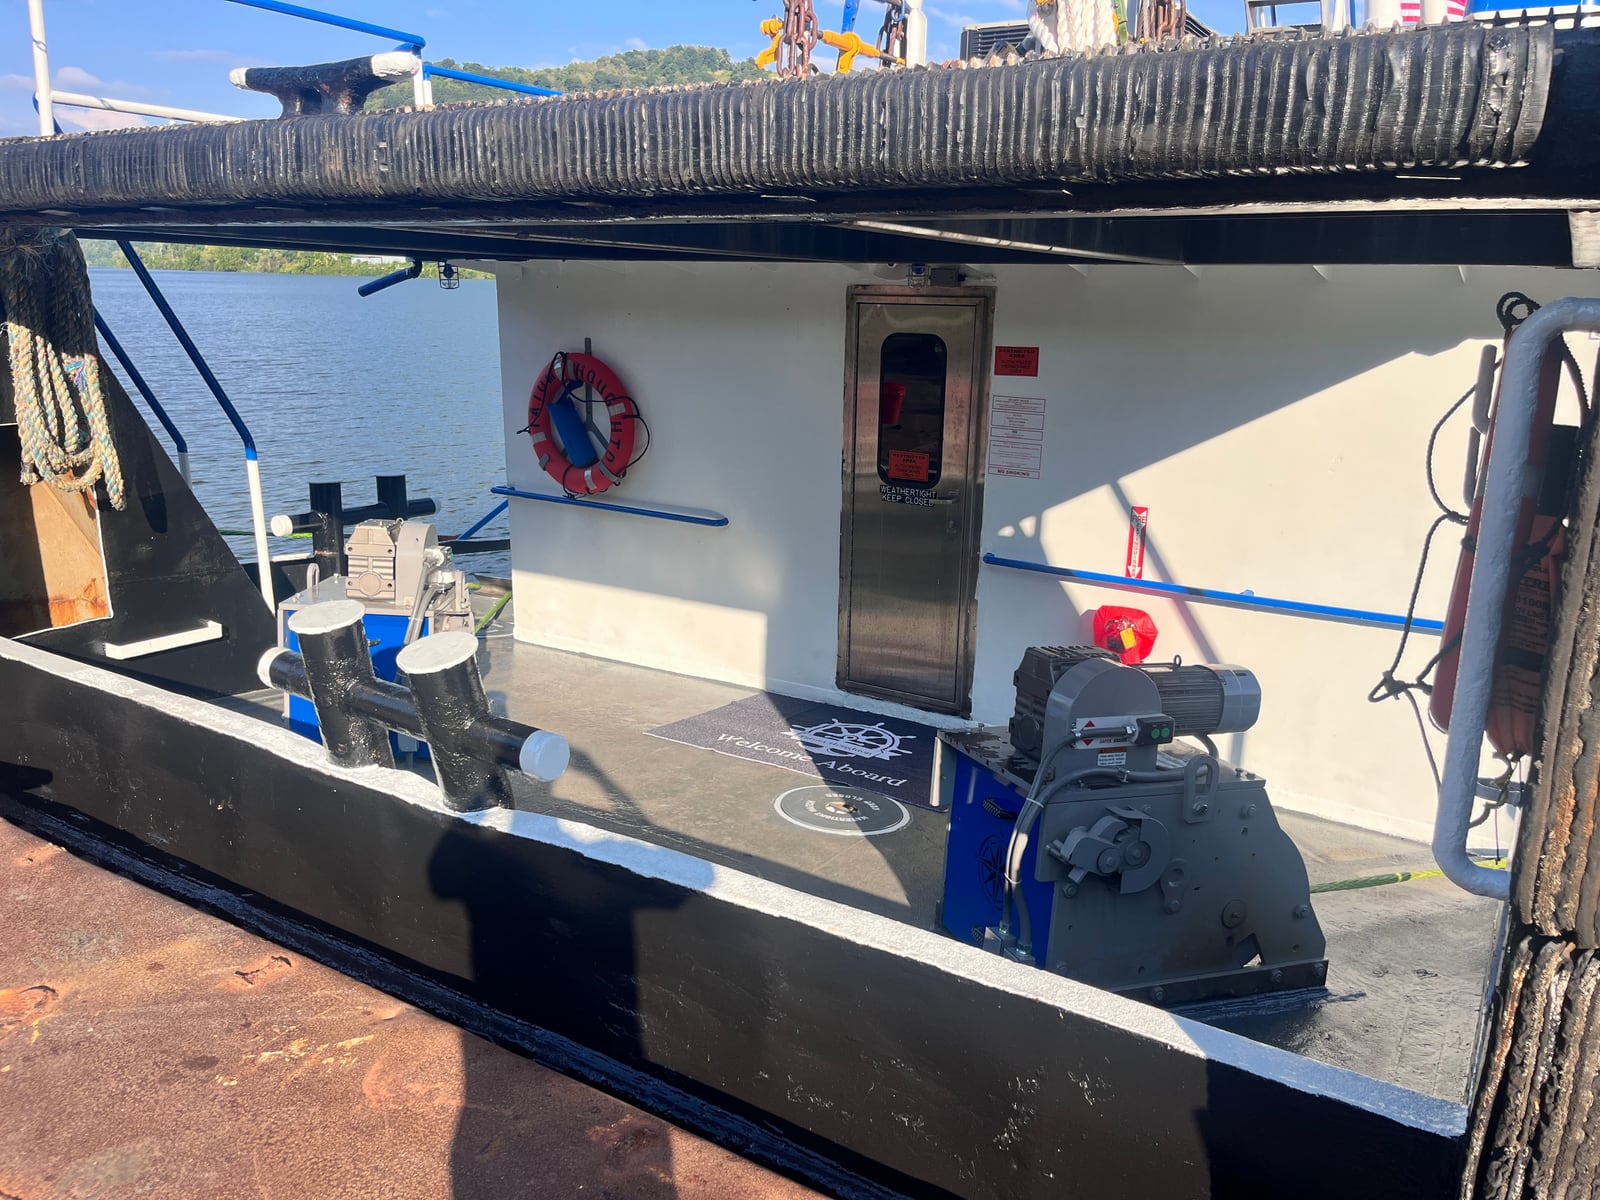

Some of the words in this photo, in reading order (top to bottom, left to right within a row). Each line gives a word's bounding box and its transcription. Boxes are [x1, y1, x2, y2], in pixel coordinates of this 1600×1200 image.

[880, 485, 937, 499] WEATHERTIGHT
[882, 493, 902, 502] KEEP
[1131, 515, 1147, 524] FIRE
[716, 733, 813, 762] Welcome
[816, 759, 908, 787] Aboard
